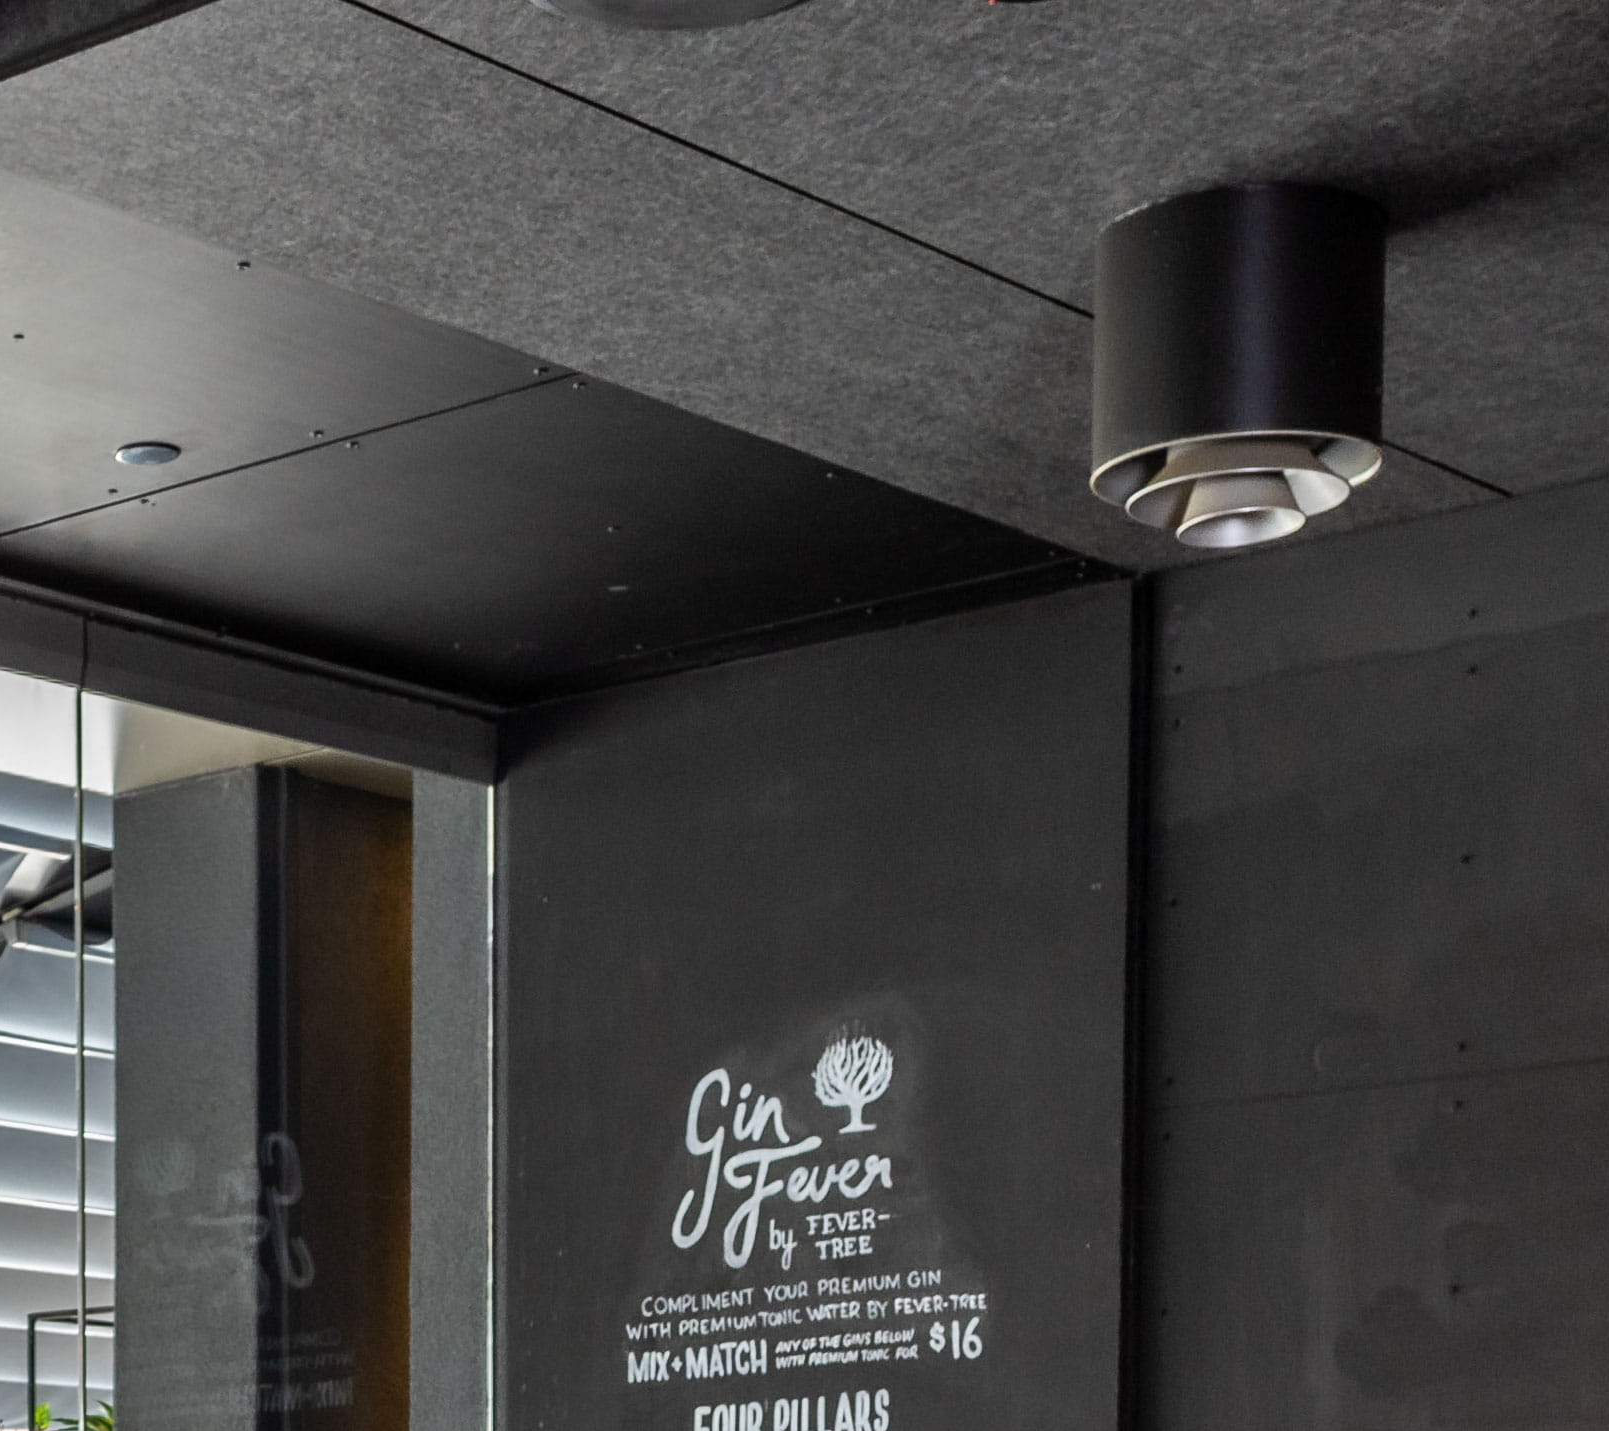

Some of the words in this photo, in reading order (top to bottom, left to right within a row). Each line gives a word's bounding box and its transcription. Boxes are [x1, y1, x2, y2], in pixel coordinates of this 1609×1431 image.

[671, 1068, 790, 1249] Gin
[723, 1135, 891, 1268] Fever
[769, 1219, 798, 1271] by
[805, 1208, 890, 1236] FEVER-
[815, 1235, 873, 1260] TREE
[641, 1287, 755, 1317] COMPLIMENT
[764, 1281, 808, 1303] YOUR
[817, 1273, 901, 1296] PREMIUM
[907, 1269, 942, 1288] GIN
[626, 1322, 672, 1341] WITH
[679, 1314, 757, 1336] PREMIUM
[758, 1308, 803, 1327] TONIC
[806, 1301, 860, 1322] WATER
[867, 1300, 888, 1319] BY
[775, 1340, 801, 1354] ANY
[802, 1337, 817, 1350] OF
[819, 1334, 840, 1348] THE
[843, 1331, 871, 1347] GINS
[874, 1328, 915, 1344] BELOW
[929, 1316, 982, 1360] $16
[775, 1354, 805, 1370] WITH
[808, 1350, 859, 1366] PREMIUM
[861, 1348, 890, 1362] TONIC
[895, 1344, 918, 1360] FOR
